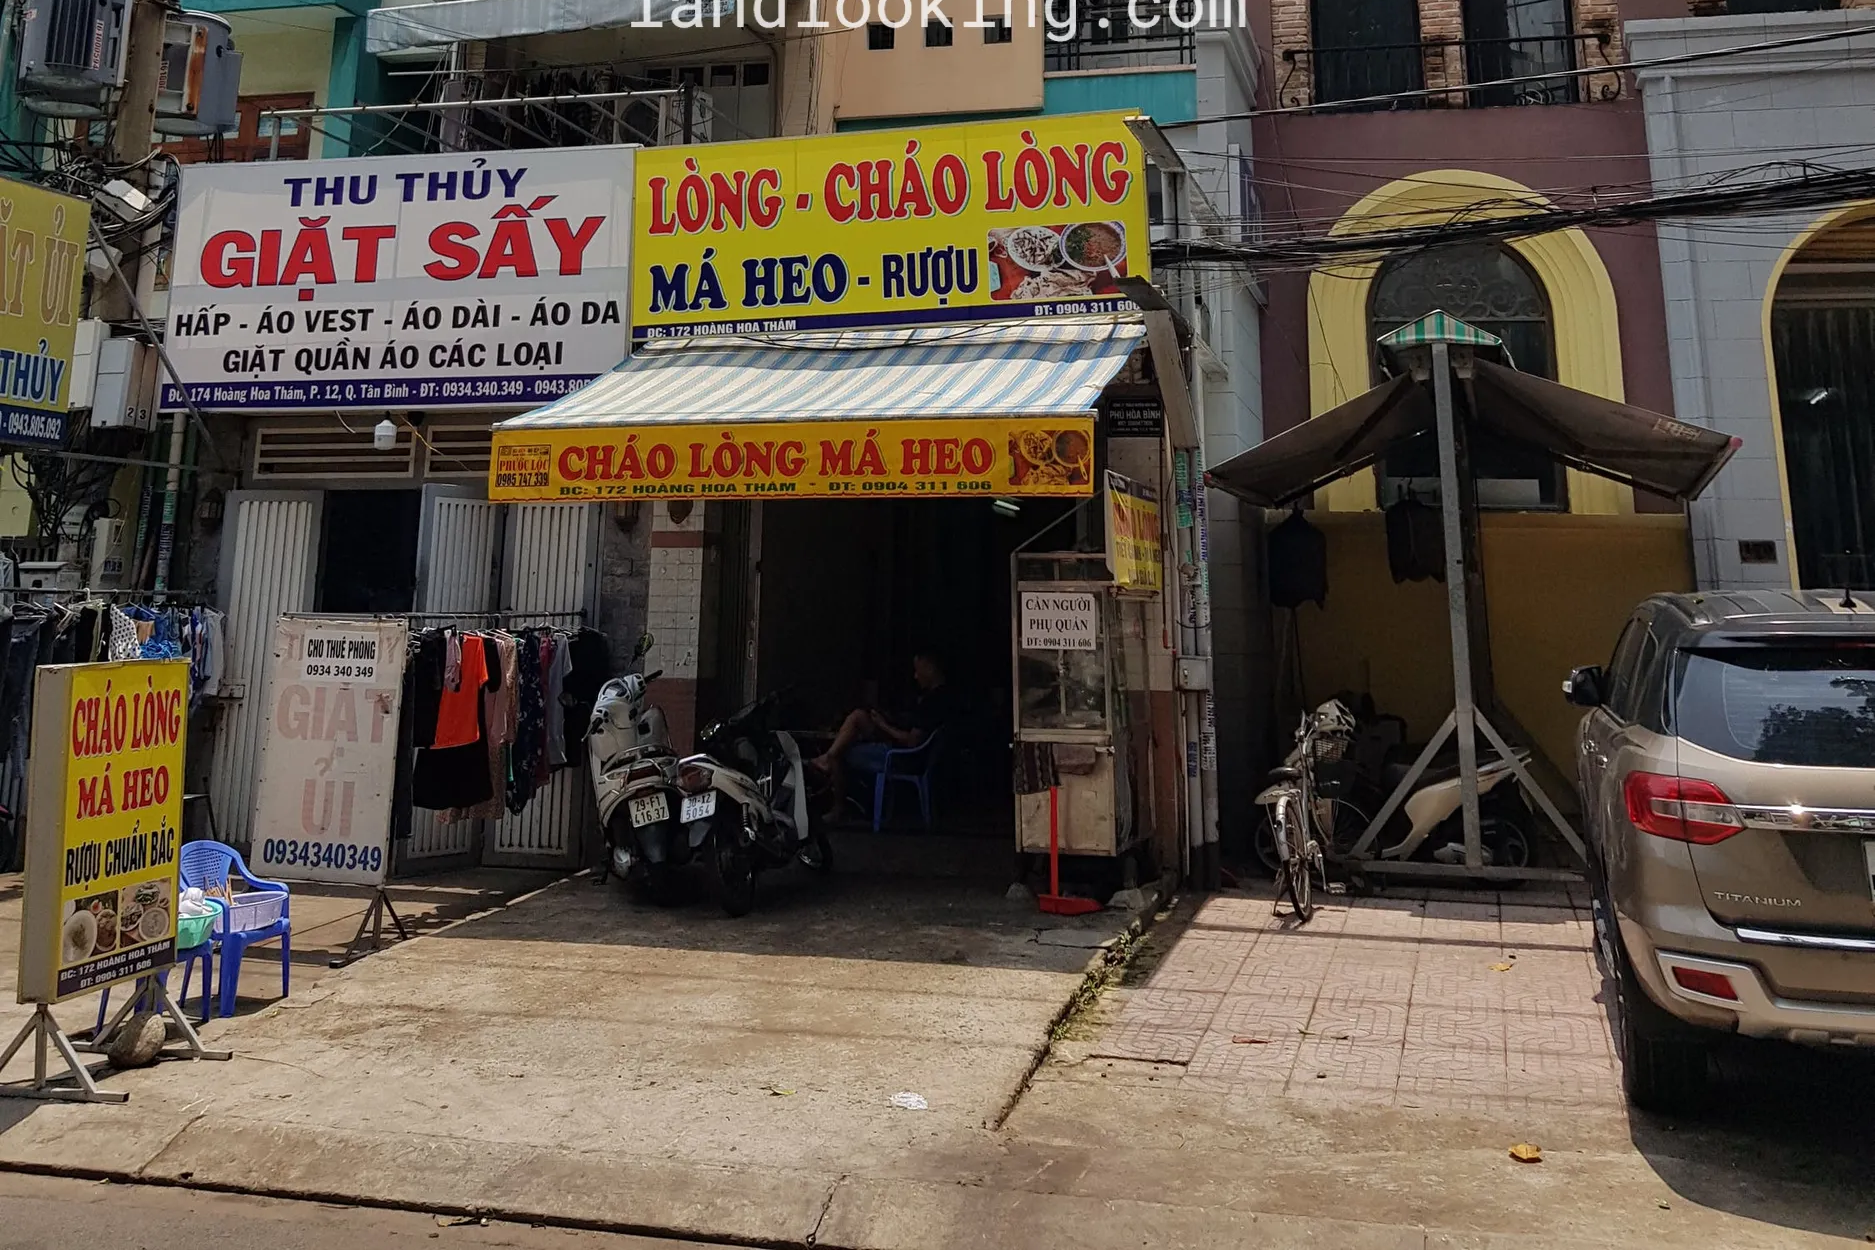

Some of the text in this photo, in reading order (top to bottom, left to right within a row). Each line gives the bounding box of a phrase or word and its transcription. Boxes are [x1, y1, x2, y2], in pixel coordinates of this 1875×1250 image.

[284, 158, 528, 207] THU THỦY
[648, 157, 784, 236] LÒNG
[823, 139, 970, 224] CHÁO
[982, 129, 1132, 213] LÒNG
[201, 195, 606, 301] GIẶT SẤY
[40, 203, 79, 326] ỦI
[648, 247, 728, 314] MÁ
[741, 251, 848, 308] HEO
[882, 246, 978, 305] RƯỢU
[175, 304, 231, 337] HẤP
[256, 305, 295, 334] ÁO
[305, 308, 374, 333] VEST
[402, 301, 442, 330] ÁO
[452, 298, 501, 328] DÀI
[529, 297, 571, 326] ÁO
[581, 300, 620, 325] DA
[1034, 304, 1053, 316] ĐT:
[1056, 303, 1087, 315] 0904
[1090, 301, 1112, 313] 311
[670, 326, 691, 337] 172
[693, 322, 733, 336] HOÀNG
[736, 322, 760, 333] HOA
[763, 318, 797, 332] THÁM
[0, 338, 65, 403] THỦY
[223, 337, 563, 379] GIẶT QUẦN ÁO CÁC LOẠI
[190, 387, 211, 402] 174
[213, 386, 247, 403] Hoàng
[250, 386, 271, 400] Hoa
[274, 385, 306, 402] Thám,
[309, 385, 321, 399] P.
[325, 384, 342, 401] 12,
[345, 384, 357, 401] Q.
[360, 383, 381, 398] Tân
[384, 382, 409, 398] Bình
[420, 382, 439, 397] ĐT:
[442, 380, 523, 397] 0934.340.349
[8, 412, 61, 440] 0943.805.092
[127, 406, 134, 419] 2
[140, 409, 146, 420] 3
[558, 428, 996, 481] CHÁO LÒNG MÁ HEO
[595, 485, 627, 494] 172
[632, 483, 695, 494] HOÀNG
[701, 483, 737, 493] HOA
[862, 481, 908, 490] 0904
[915, 481, 948, 490] 311
[957, 480, 992, 490] 606
[1053, 596, 1091, 611] NGƯỜI
[1029, 616, 1088, 633] PHỤ QUÁN
[307, 638, 324, 658] CHO
[347, 635, 376, 660] PHÒNG
[1043, 637, 1061, 647] 0904
[1063, 638, 1076, 647] 311
[306, 664, 374, 678] 0934 340 349
[72, 675, 182, 759] CHÁO LÒNG
[76, 761, 170, 821] MÁ HEO
[65, 815, 174, 891] RƯỢU CHUẨN BẮC
[263, 838, 382, 872] 0934340349
[1713, 891, 1802, 907] TITANIUM
[79, 963, 95, 975] 172
[97, 954, 127, 970] HOÀNG
[128, 948, 145, 961] HOA
[95, 970, 117, 983] 0904
[118, 964, 134, 976] 311
[136, 959, 152, 970] 606
